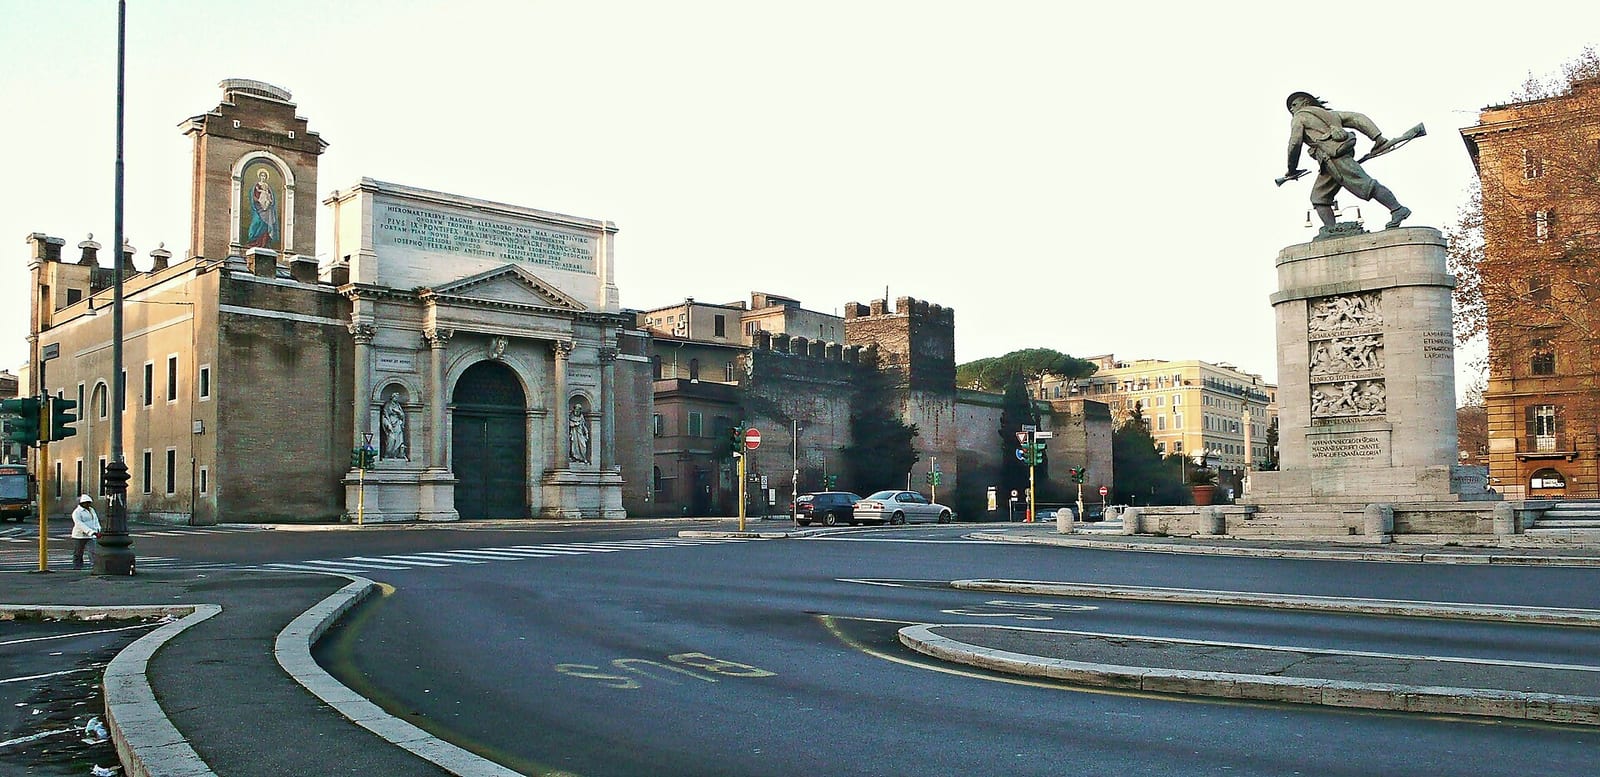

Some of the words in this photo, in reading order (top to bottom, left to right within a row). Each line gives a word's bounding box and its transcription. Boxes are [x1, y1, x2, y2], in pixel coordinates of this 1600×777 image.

[388, 218, 405, 226] PIVS
[424, 224, 458, 235] PONTIFEX
[464, 231, 496, 241] MAXIMVS
[478, 221, 512, 231] ALEXANDRO
[395, 238, 422, 247] IOSEPHO
[555, 652, 778, 690] BUS
